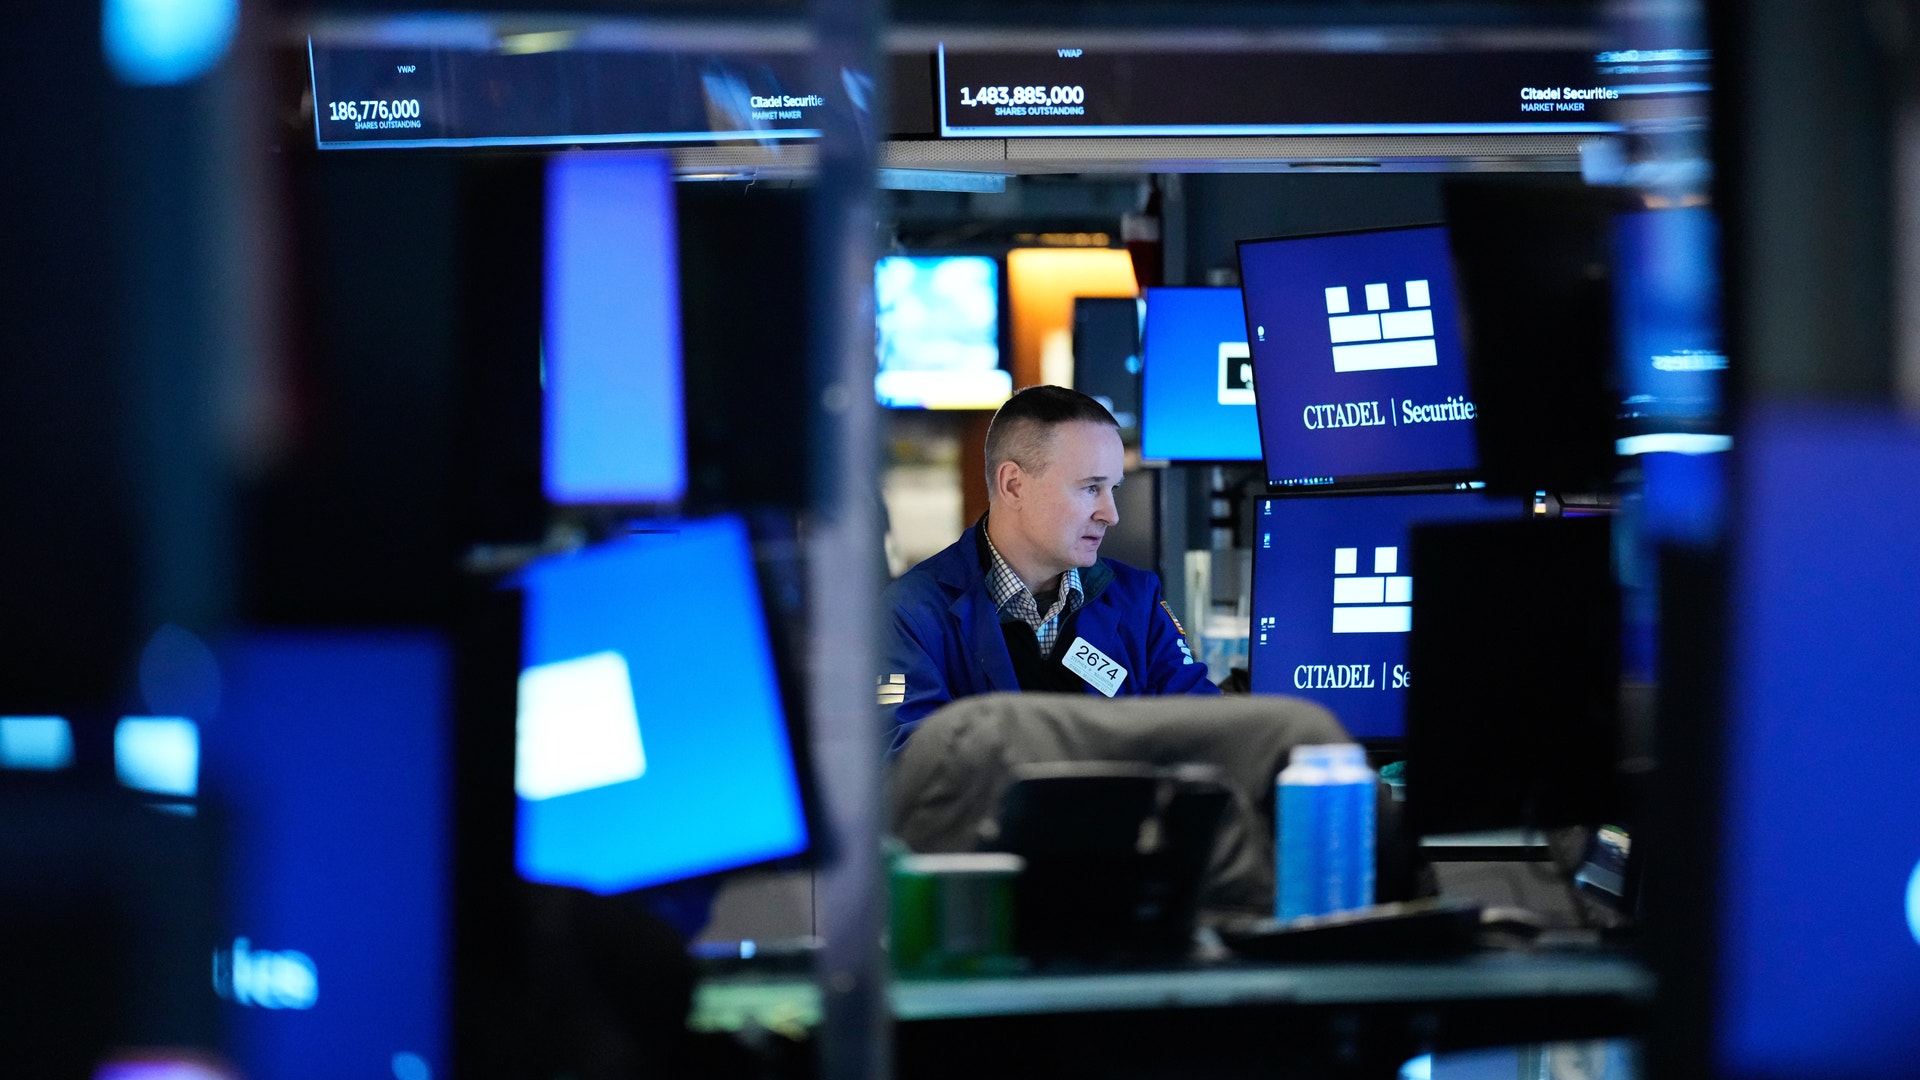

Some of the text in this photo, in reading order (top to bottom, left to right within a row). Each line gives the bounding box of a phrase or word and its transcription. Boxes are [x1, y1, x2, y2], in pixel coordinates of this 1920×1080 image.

[1057, 48, 1083, 58] VWAP
[397, 65, 416, 74] VWAP
[960, 85, 1085, 107] 1,483,885,000
[1521, 86, 1619, 100] Citadel Securities
[750, 95, 782, 108] Citadel
[1521, 102, 1585, 112] MARKET MAKER
[329, 99, 420, 122] 186,776,000
[751, 110, 802, 120] MARKET MAKER
[995, 106, 1085, 116] SHARES OUTSTANDING
[355, 119, 421, 130] SHARES OUTSTANDING
[1303, 395, 1478, 430] CITADEL Securitie
[1076, 646, 1119, 680] 2674
[1294, 664, 1374, 689] CITADEL
